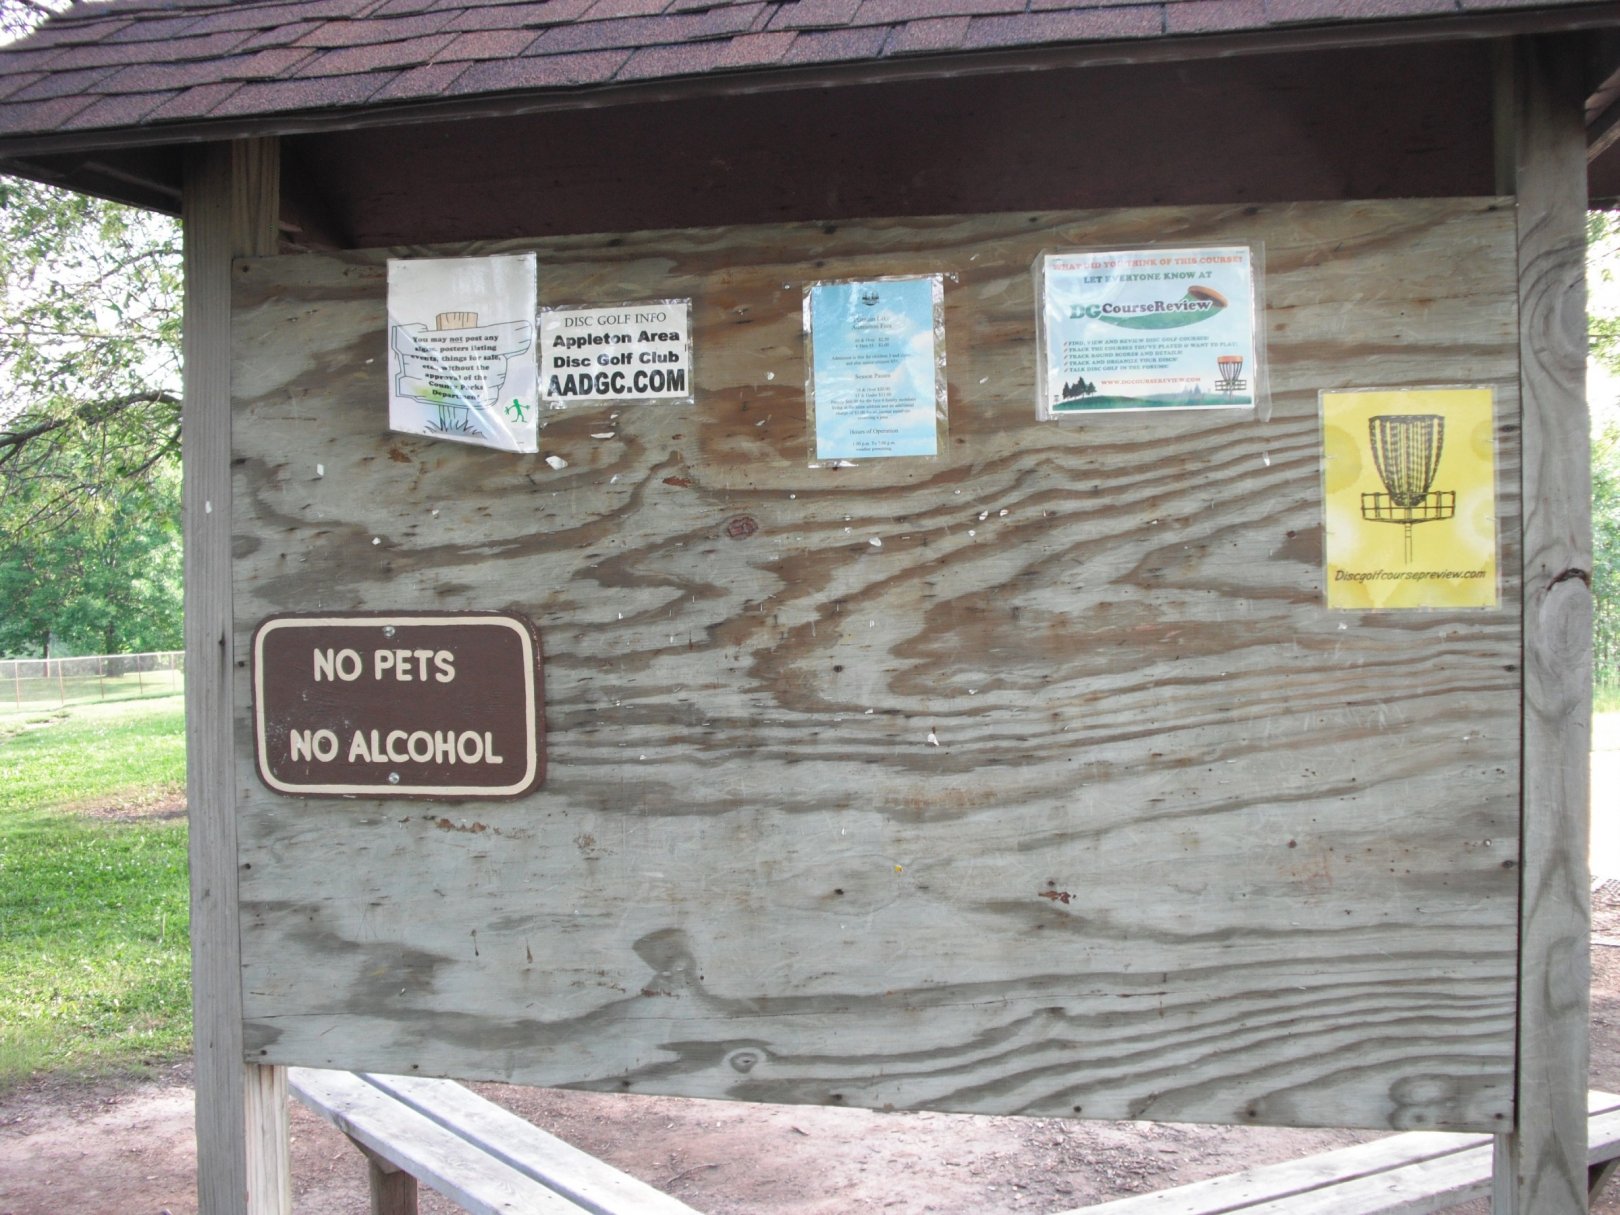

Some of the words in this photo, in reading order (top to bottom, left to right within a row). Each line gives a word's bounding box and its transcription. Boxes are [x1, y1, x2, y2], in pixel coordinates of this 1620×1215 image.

[1127, 258, 1158, 268] THINK
[1159, 256, 1172, 266] OF
[1174, 255, 1197, 266] THIS
[1083, 274, 1102, 285] LET
[1163, 270, 1196, 281] KNOW
[1197, 270, 1213, 279] AT
[564, 316, 593, 328] DISC
[597, 314, 631, 326] GOLF
[635, 311, 667, 324] INFO
[465, 335, 482, 343] post
[552, 332, 632, 349] Appleton
[637, 330, 680, 342] Area
[441, 355, 467, 363] things
[553, 356, 591, 368] Disc
[596, 352, 633, 366] Golf
[638, 351, 680, 364] Club
[546, 368, 685, 397] AADGC.COM
[313, 648, 362, 682] NO
[374, 648, 456, 683] PETS
[290, 729, 339, 762] NO
[348, 729, 504, 765] ALCOHOL
